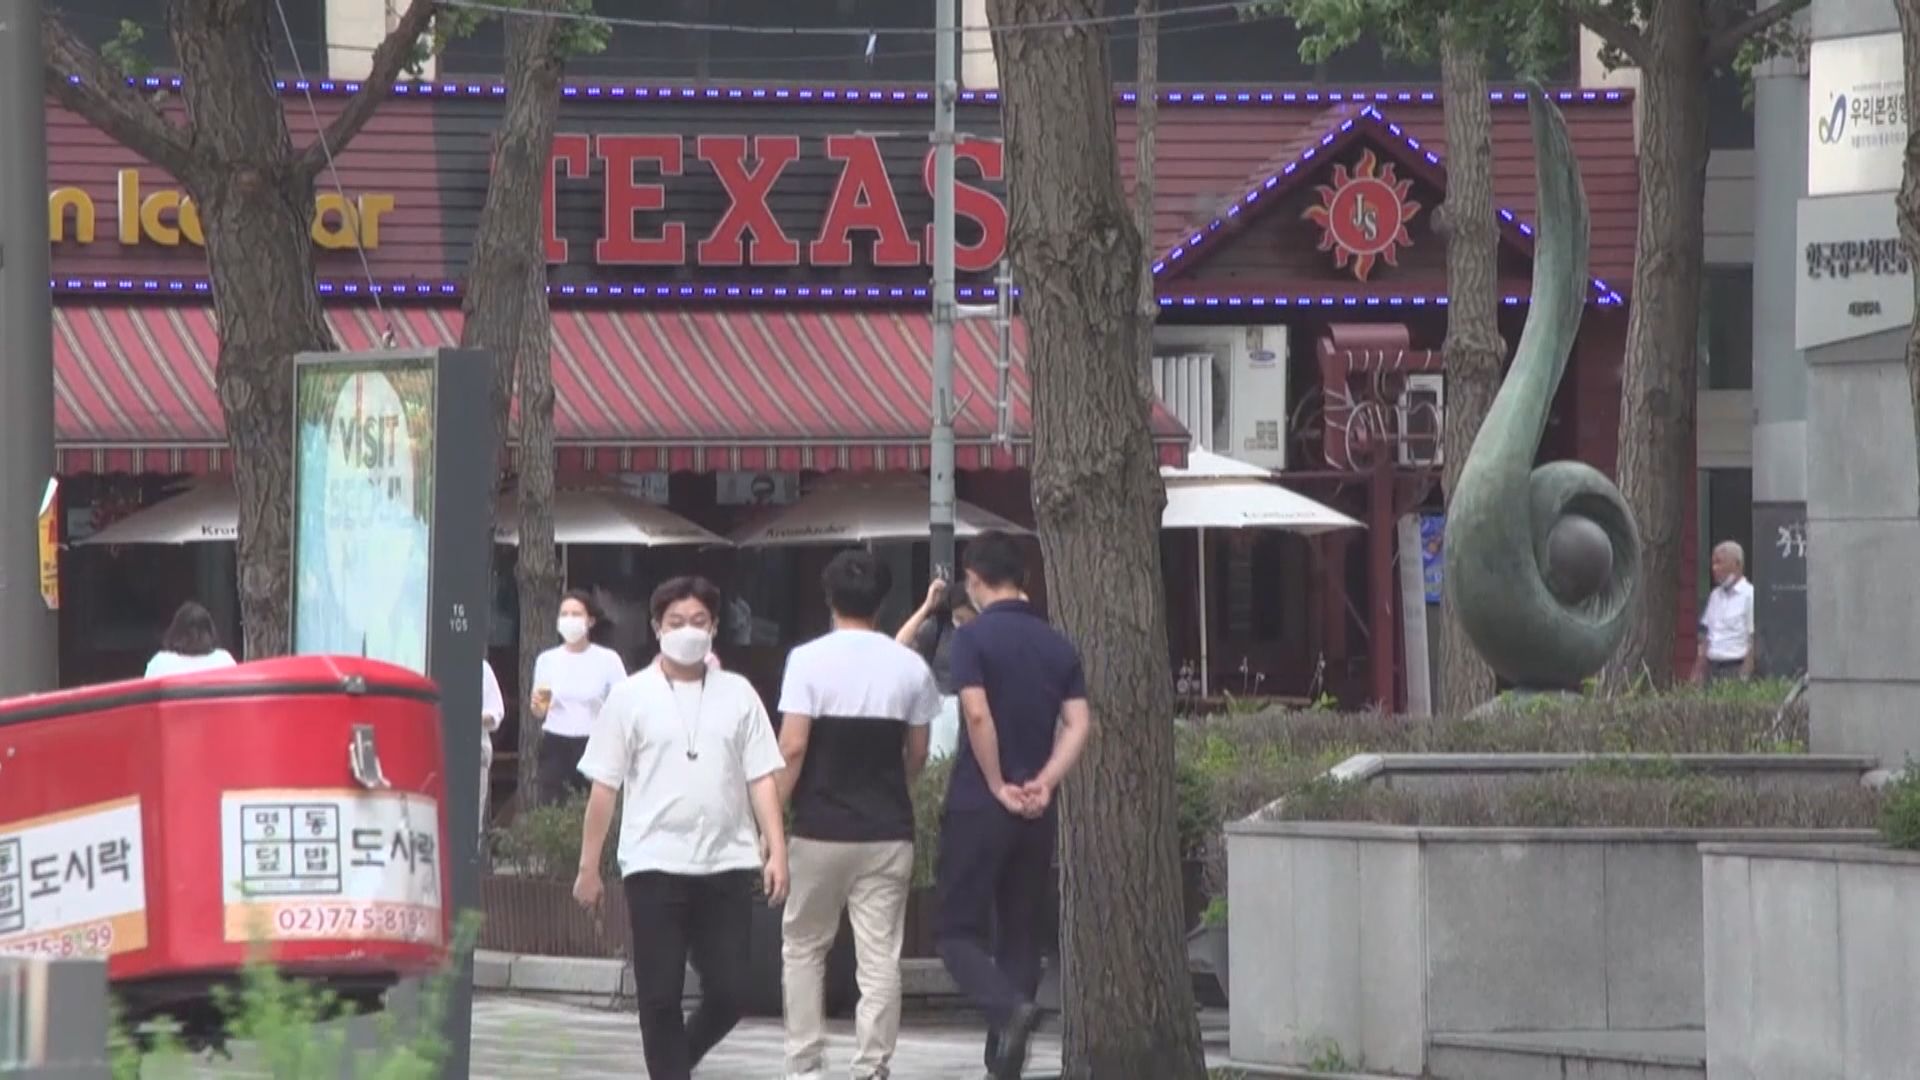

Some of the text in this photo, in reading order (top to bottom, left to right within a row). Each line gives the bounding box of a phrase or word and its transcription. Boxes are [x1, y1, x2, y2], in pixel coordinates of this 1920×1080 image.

[311, 193, 396, 250] ar
[338, 414, 399, 470] VISIT
[29, 836, 132, 900] 도시락
